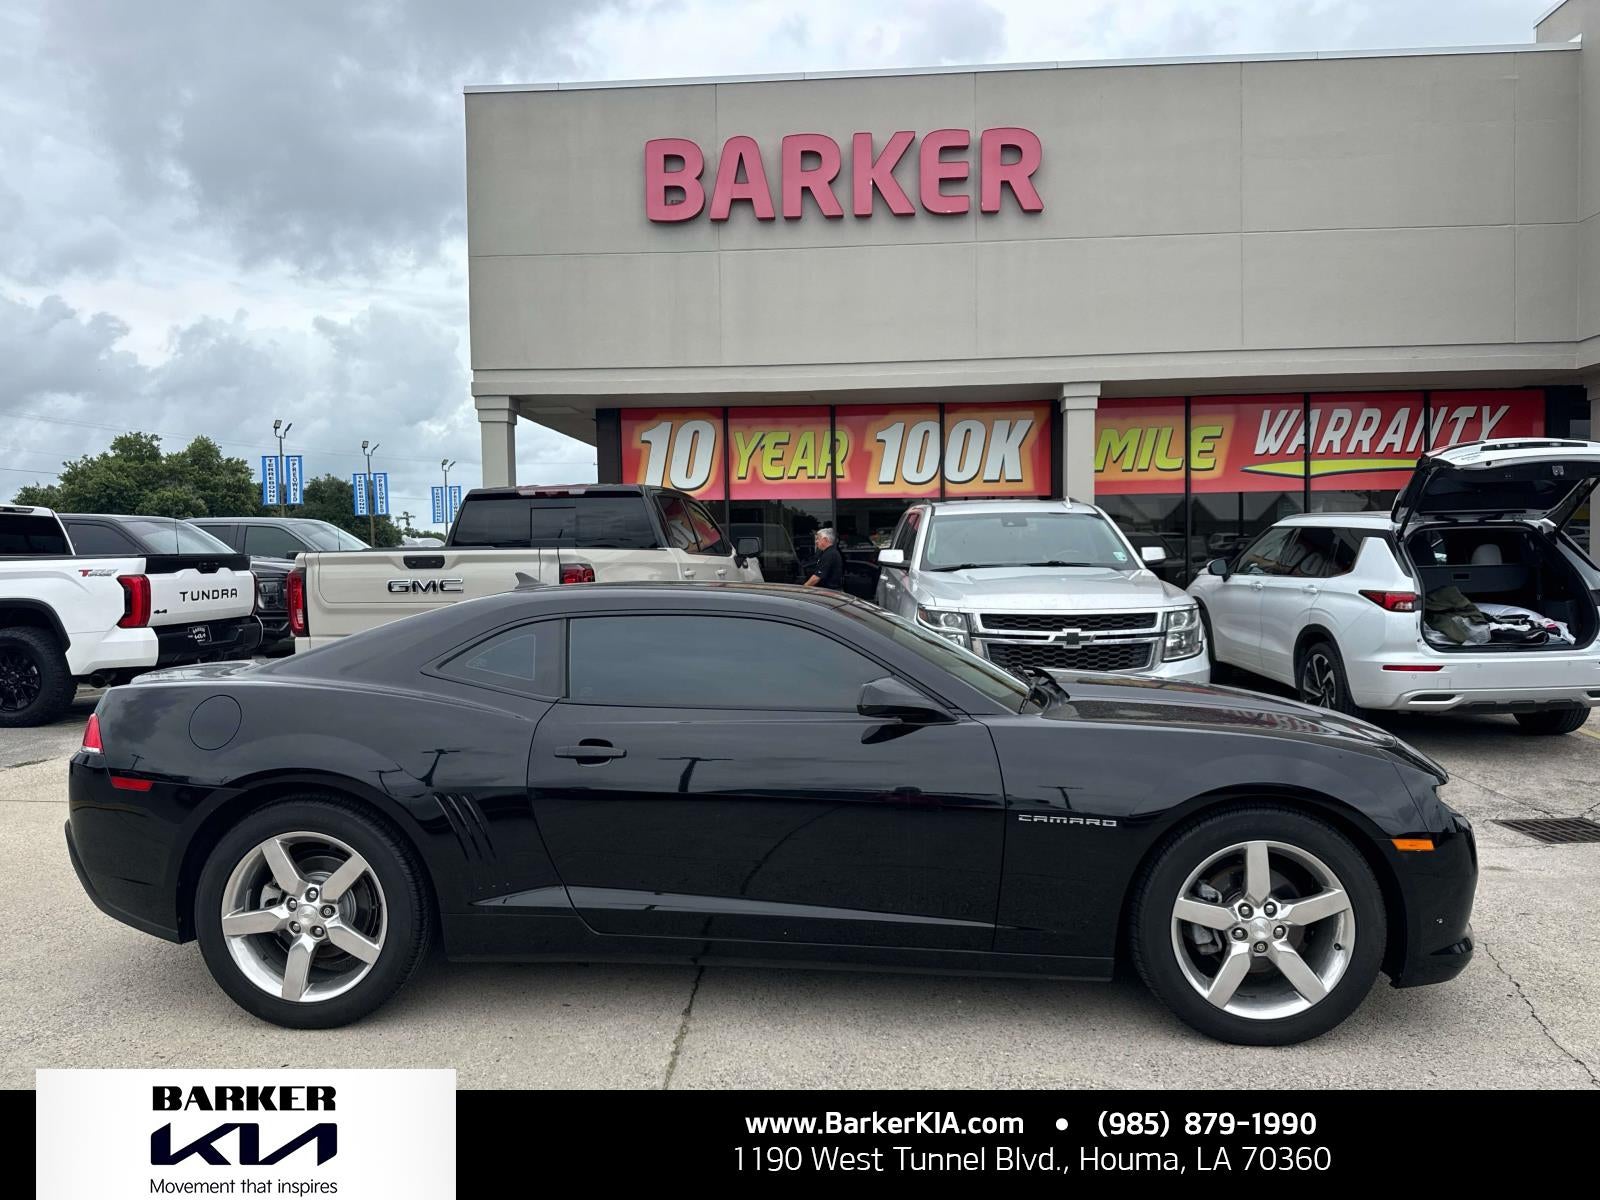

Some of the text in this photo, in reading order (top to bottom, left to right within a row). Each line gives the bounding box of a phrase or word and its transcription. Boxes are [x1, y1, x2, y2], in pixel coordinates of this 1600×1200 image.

[645, 127, 1045, 222] BARKER
[640, 418, 1034, 491] 10 YEAR 100K
[1094, 405, 1509, 472] MILE WARRANTY
[267, 458, 276, 503] TERREBONNE
[179, 588, 238, 602] TUNDRA
[387, 578, 464, 593] GMC
[1018, 814, 1118, 827] CAMARO
